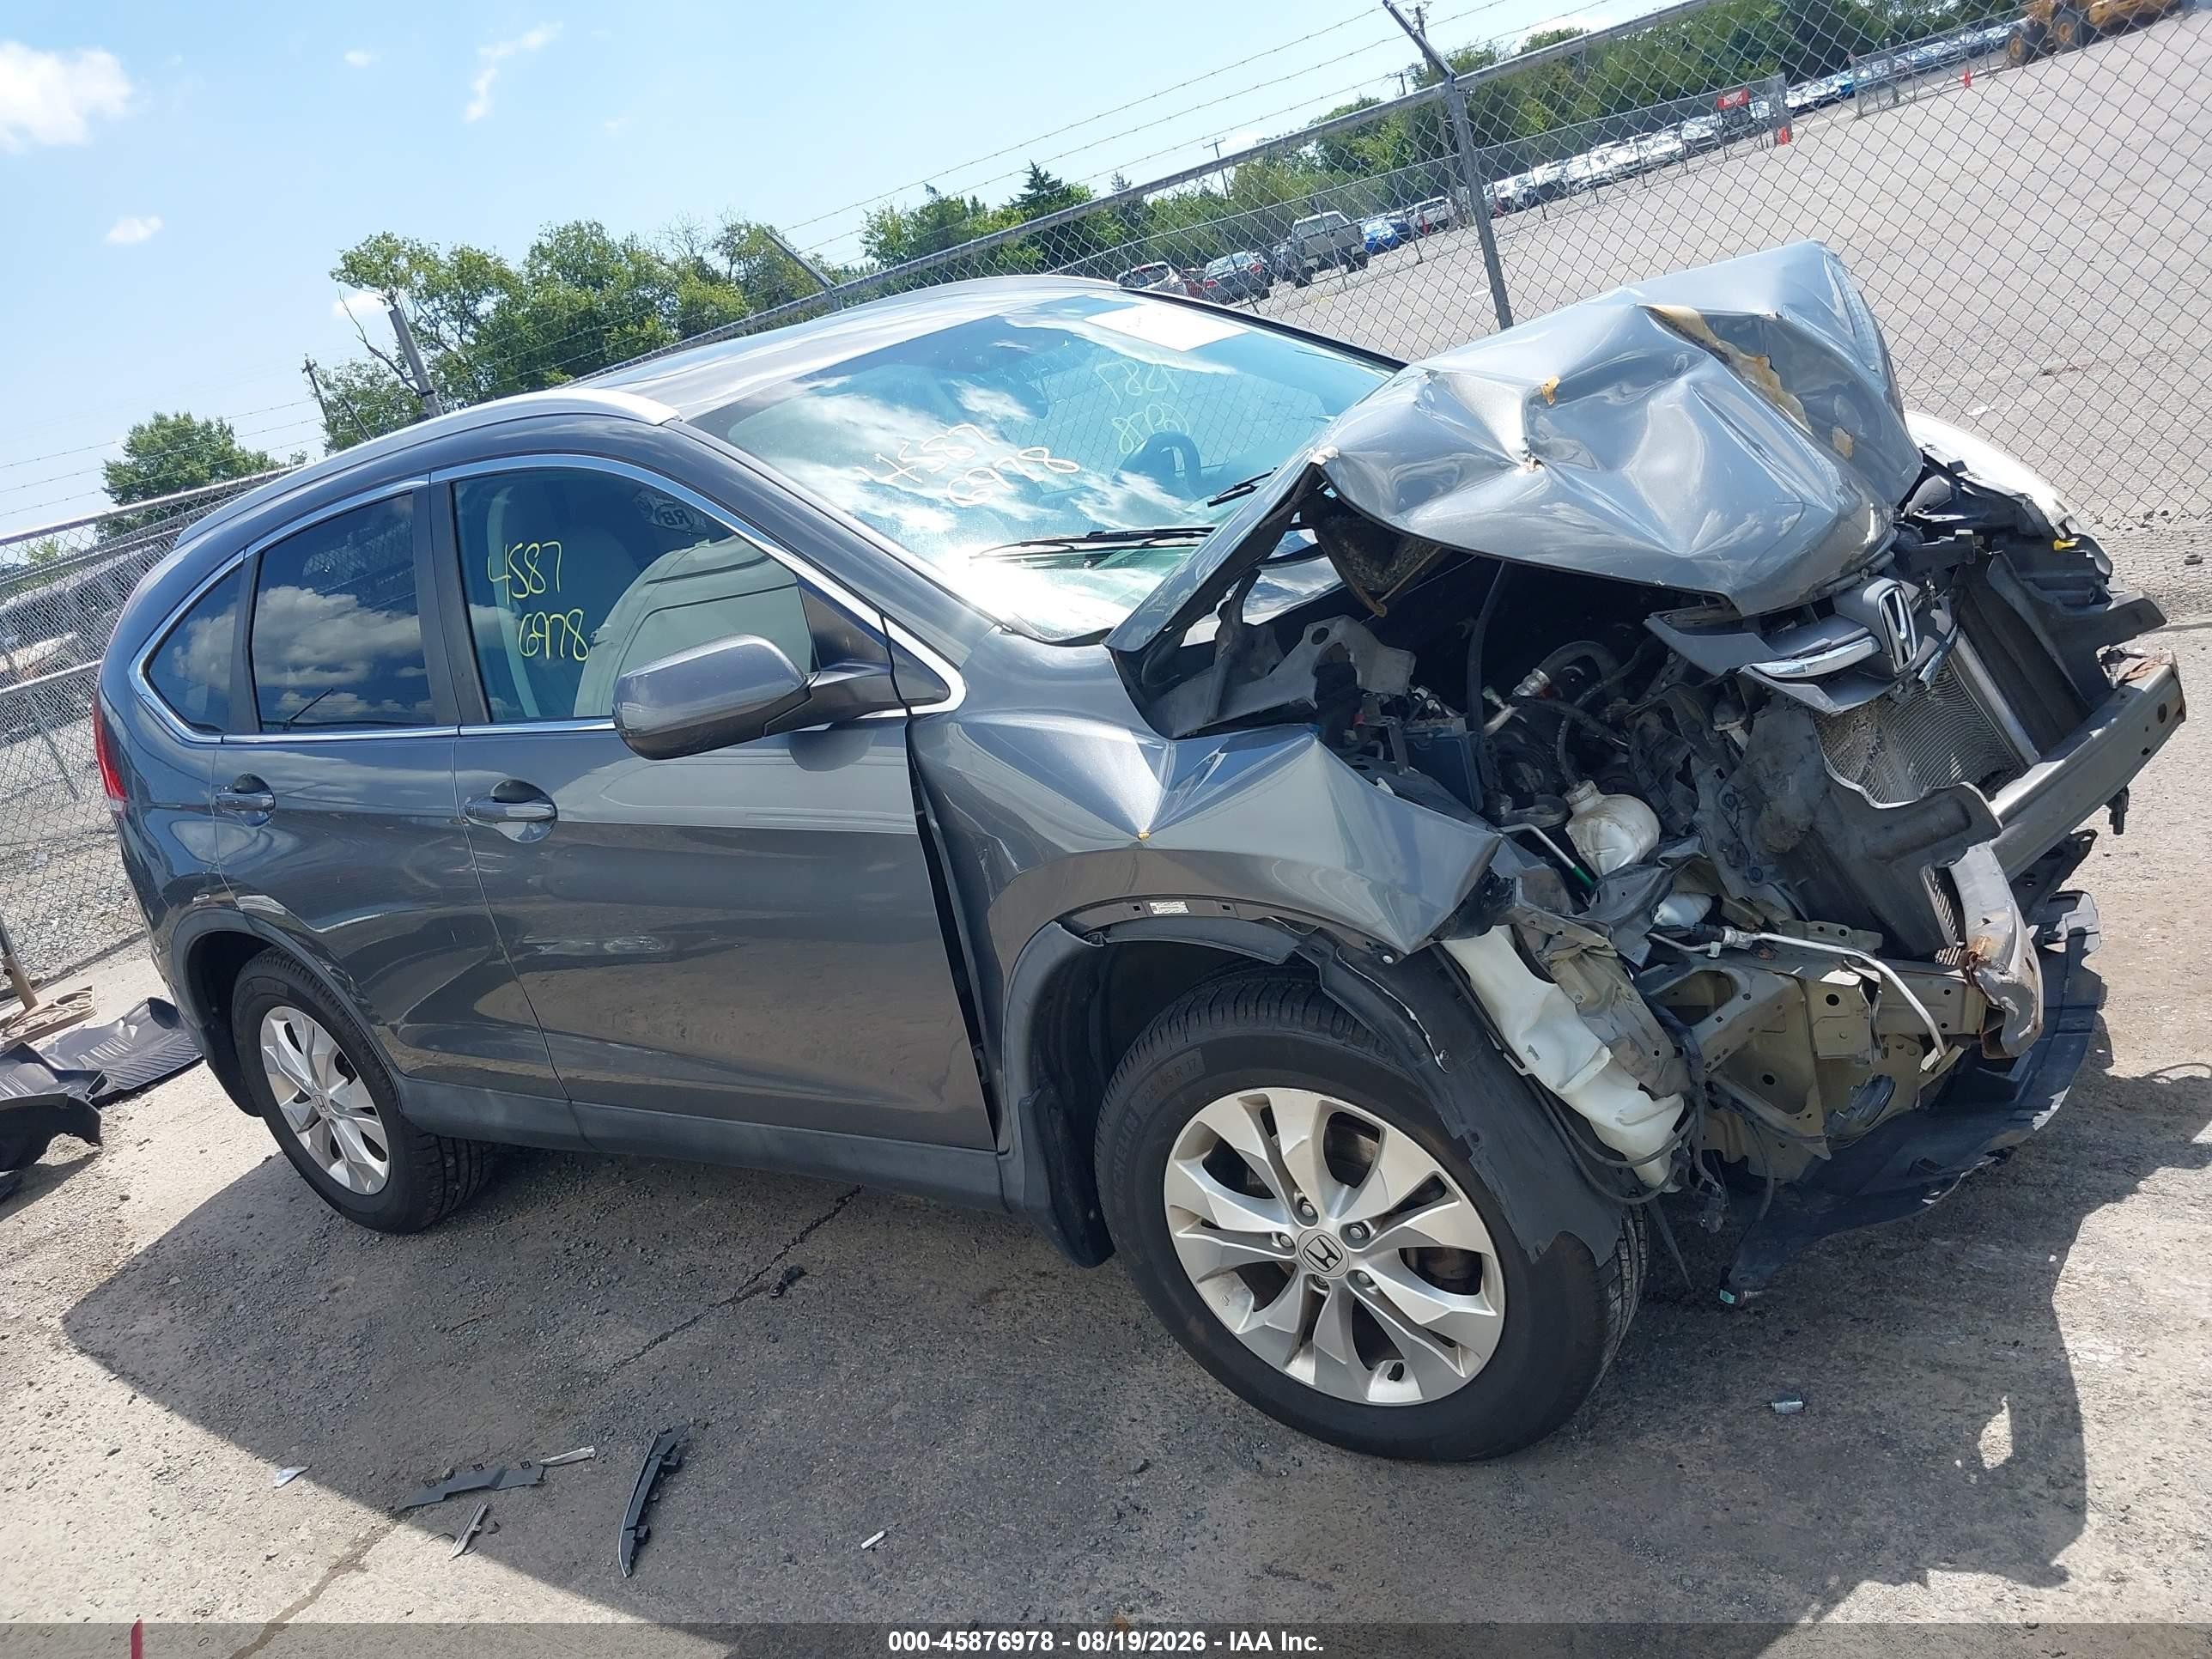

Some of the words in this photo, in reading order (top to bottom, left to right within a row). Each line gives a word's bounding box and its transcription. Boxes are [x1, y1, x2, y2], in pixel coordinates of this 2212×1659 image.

[851, 422, 999, 484] 4587
[946, 447, 1081, 507] 6978
[487, 538, 562, 605] 4587
[518, 608, 590, 662] 6978
